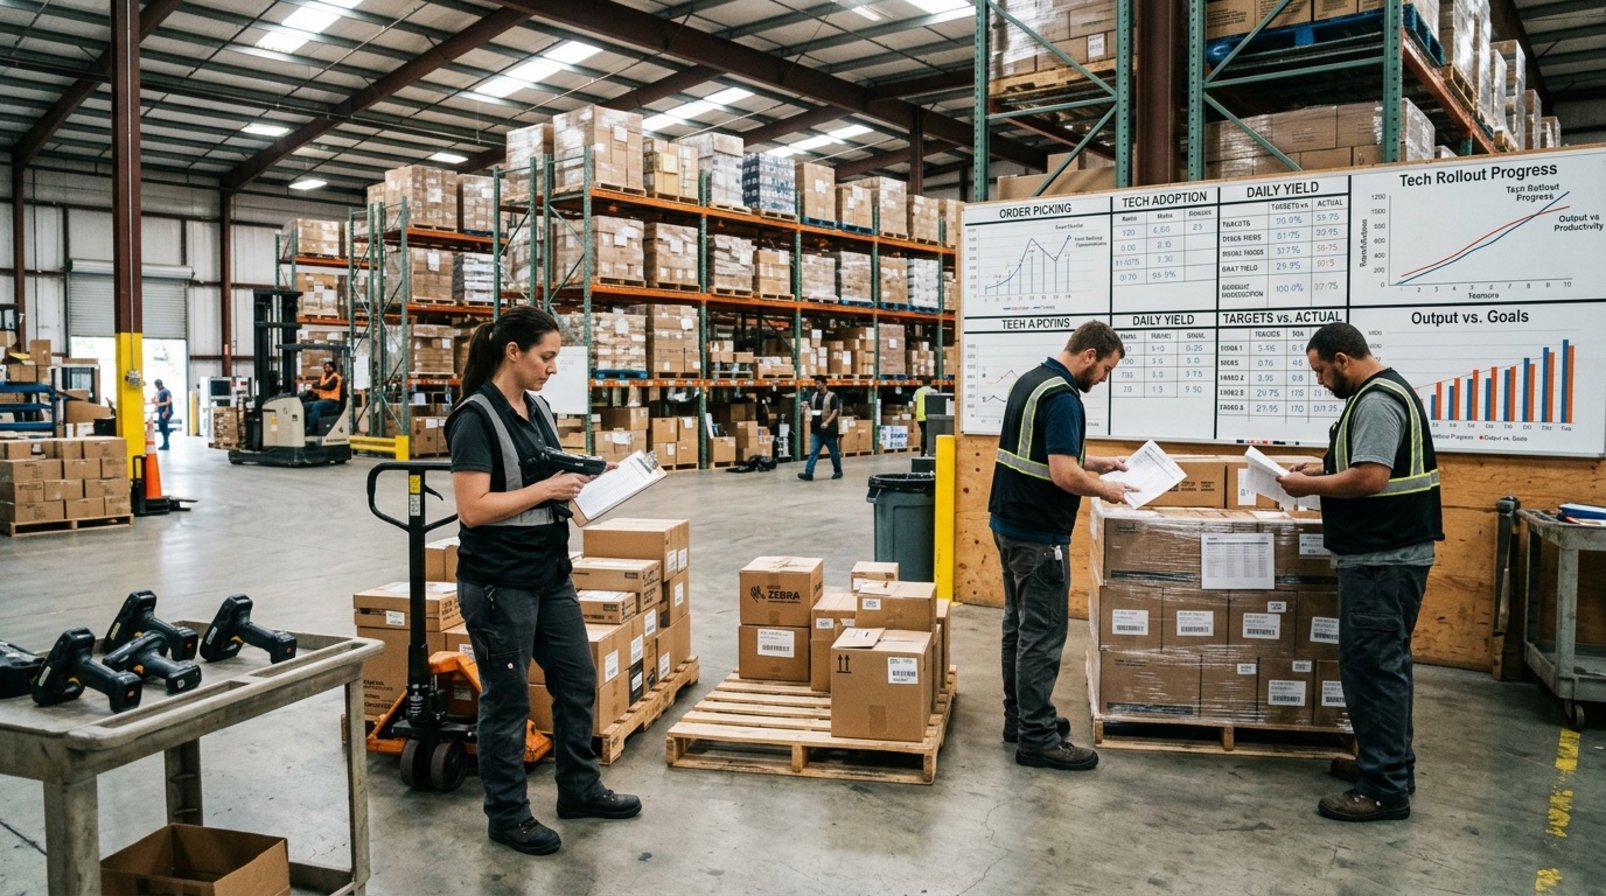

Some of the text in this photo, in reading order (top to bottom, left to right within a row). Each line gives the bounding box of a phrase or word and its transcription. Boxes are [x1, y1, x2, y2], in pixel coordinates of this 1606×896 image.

[1400, 164, 1557, 187] Tech Rollout Progress
[1247, 182, 1319, 198] DAILY YIELD
[1122, 191, 1207, 208] TECH ADOPTION
[1317, 199, 1343, 207] ACTUAL
[999, 203, 1072, 219] ORDER PICKING
[1559, 214, 1587, 223] Output
[1554, 223, 1604, 232] Productivity
[1132, 314, 1194, 326] DAILY YIELD
[1223, 311, 1342, 324] TARGETS vs. ACTUAL
[1411, 309, 1529, 327] Output vs. Goals
[768, 590, 800, 600] ZEBRA
